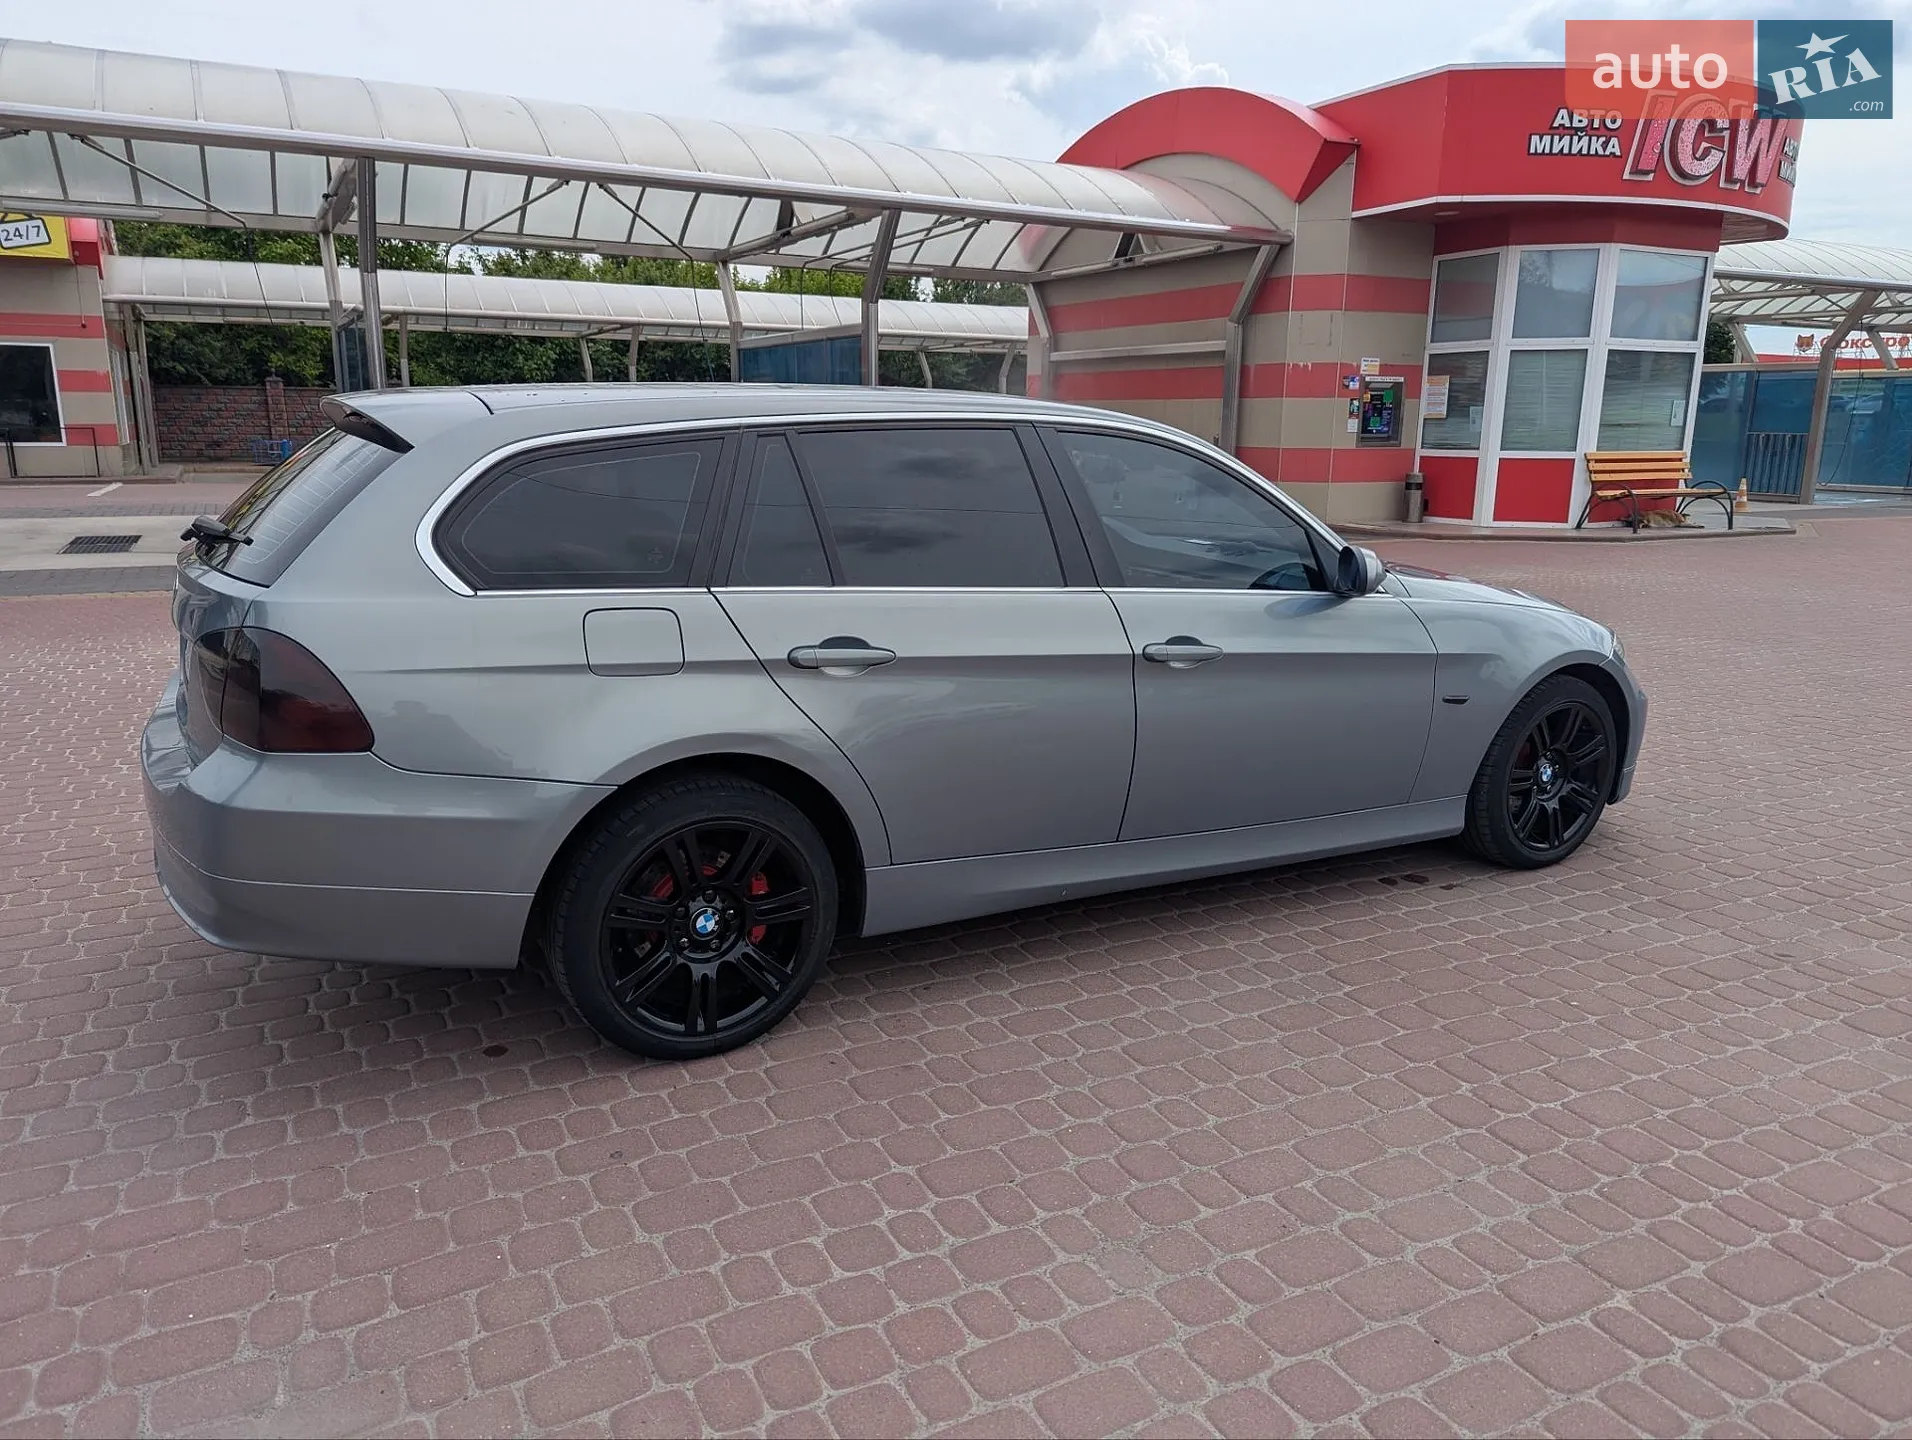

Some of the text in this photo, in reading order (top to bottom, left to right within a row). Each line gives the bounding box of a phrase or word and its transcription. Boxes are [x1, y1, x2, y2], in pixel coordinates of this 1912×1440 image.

[1552, 108, 1622, 131] АВТО
[1528, 131, 1622, 157] МИЙКА
[1, 224, 41, 242] 24/7
